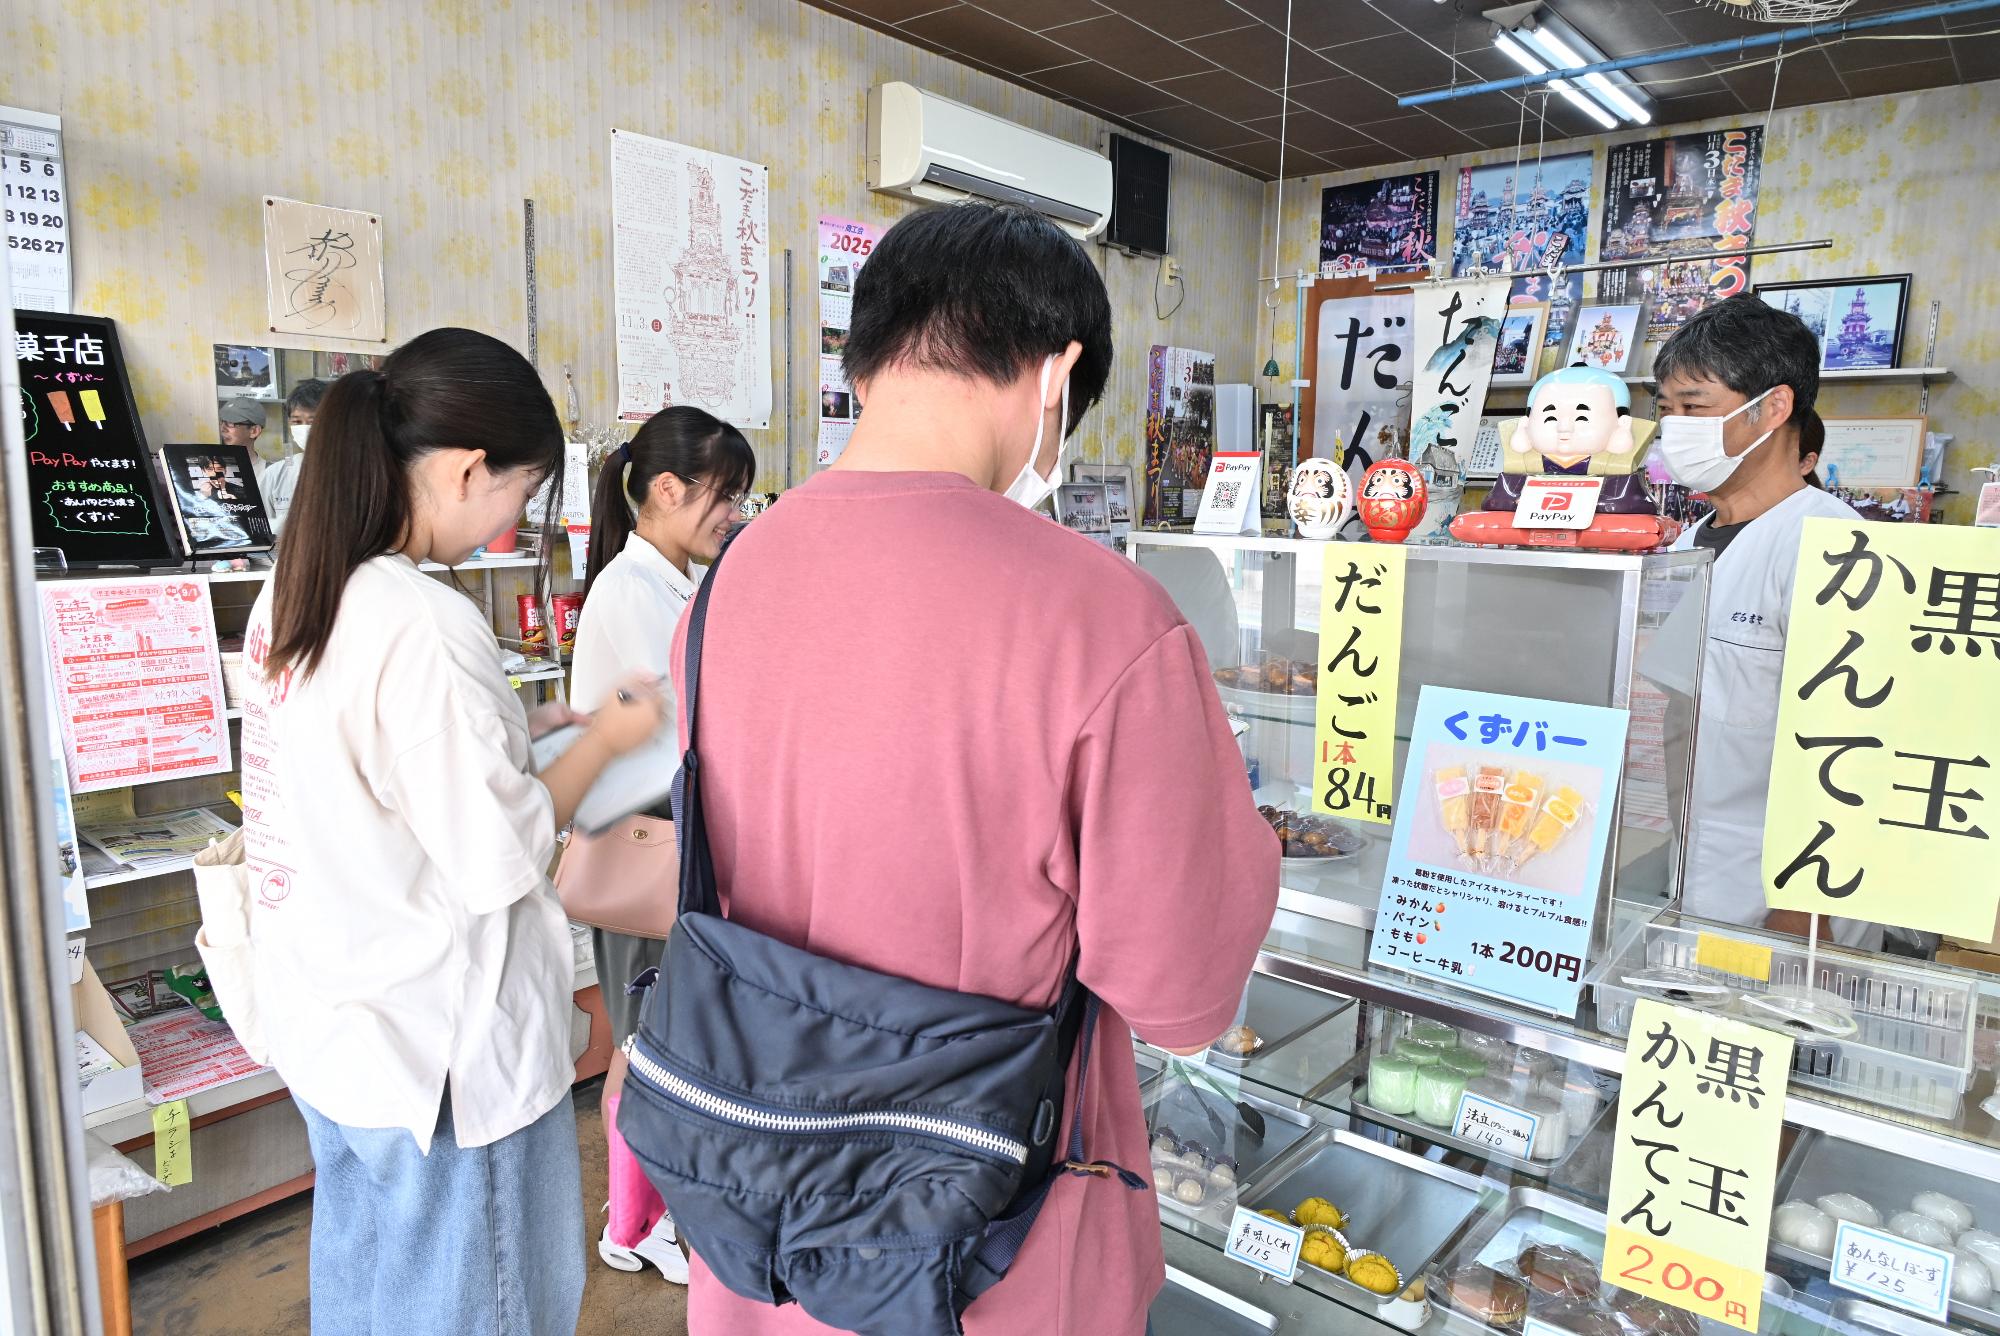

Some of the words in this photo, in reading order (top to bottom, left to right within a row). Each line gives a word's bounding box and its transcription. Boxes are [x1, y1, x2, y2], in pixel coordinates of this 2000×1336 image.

[20, 160, 31, 173] 5
[43, 164, 55, 177] 6
[17, 186, 37, 199] 12
[41, 189, 60, 203] 13
[19, 211, 38, 225] 19
[42, 214, 64, 229] 20
[20, 236, 42, 251] 26
[44, 239, 64, 253] 27
[831, 232, 872, 256] 2025
[1438, 290, 1485, 448] だんご
[1225, 463, 1252, 472] PayPay
[1529, 512, 1576, 522] PayPay
[57, 611, 95, 621] チャンス
[1328, 562, 1387, 740] だんご
[1774, 530, 1917, 899] かんてん
[1444, 711, 1587, 751] くずバー
[1322, 741, 1356, 765] 1本
[1324, 767, 1392, 820] 84円
[1396, 894, 1433, 913] みかん
[1393, 911, 1430, 928] パイン
[1390, 927, 1413, 943] もも
[1387, 945, 1463, 975] コーヒー牛乳
[1470, 942, 1495, 959] 1本
[1499, 941, 1582, 983] 200円
[1462, 1122, 1503, 1146] ¥140
[1621, 1021, 1696, 1237] かんてん
[1680, 1036, 1766, 1227] 黒玉
[1235, 1237, 1271, 1261] ¥115
[1619, 1244, 1748, 1326] 200円
[1846, 1260, 1905, 1293] ¥125
